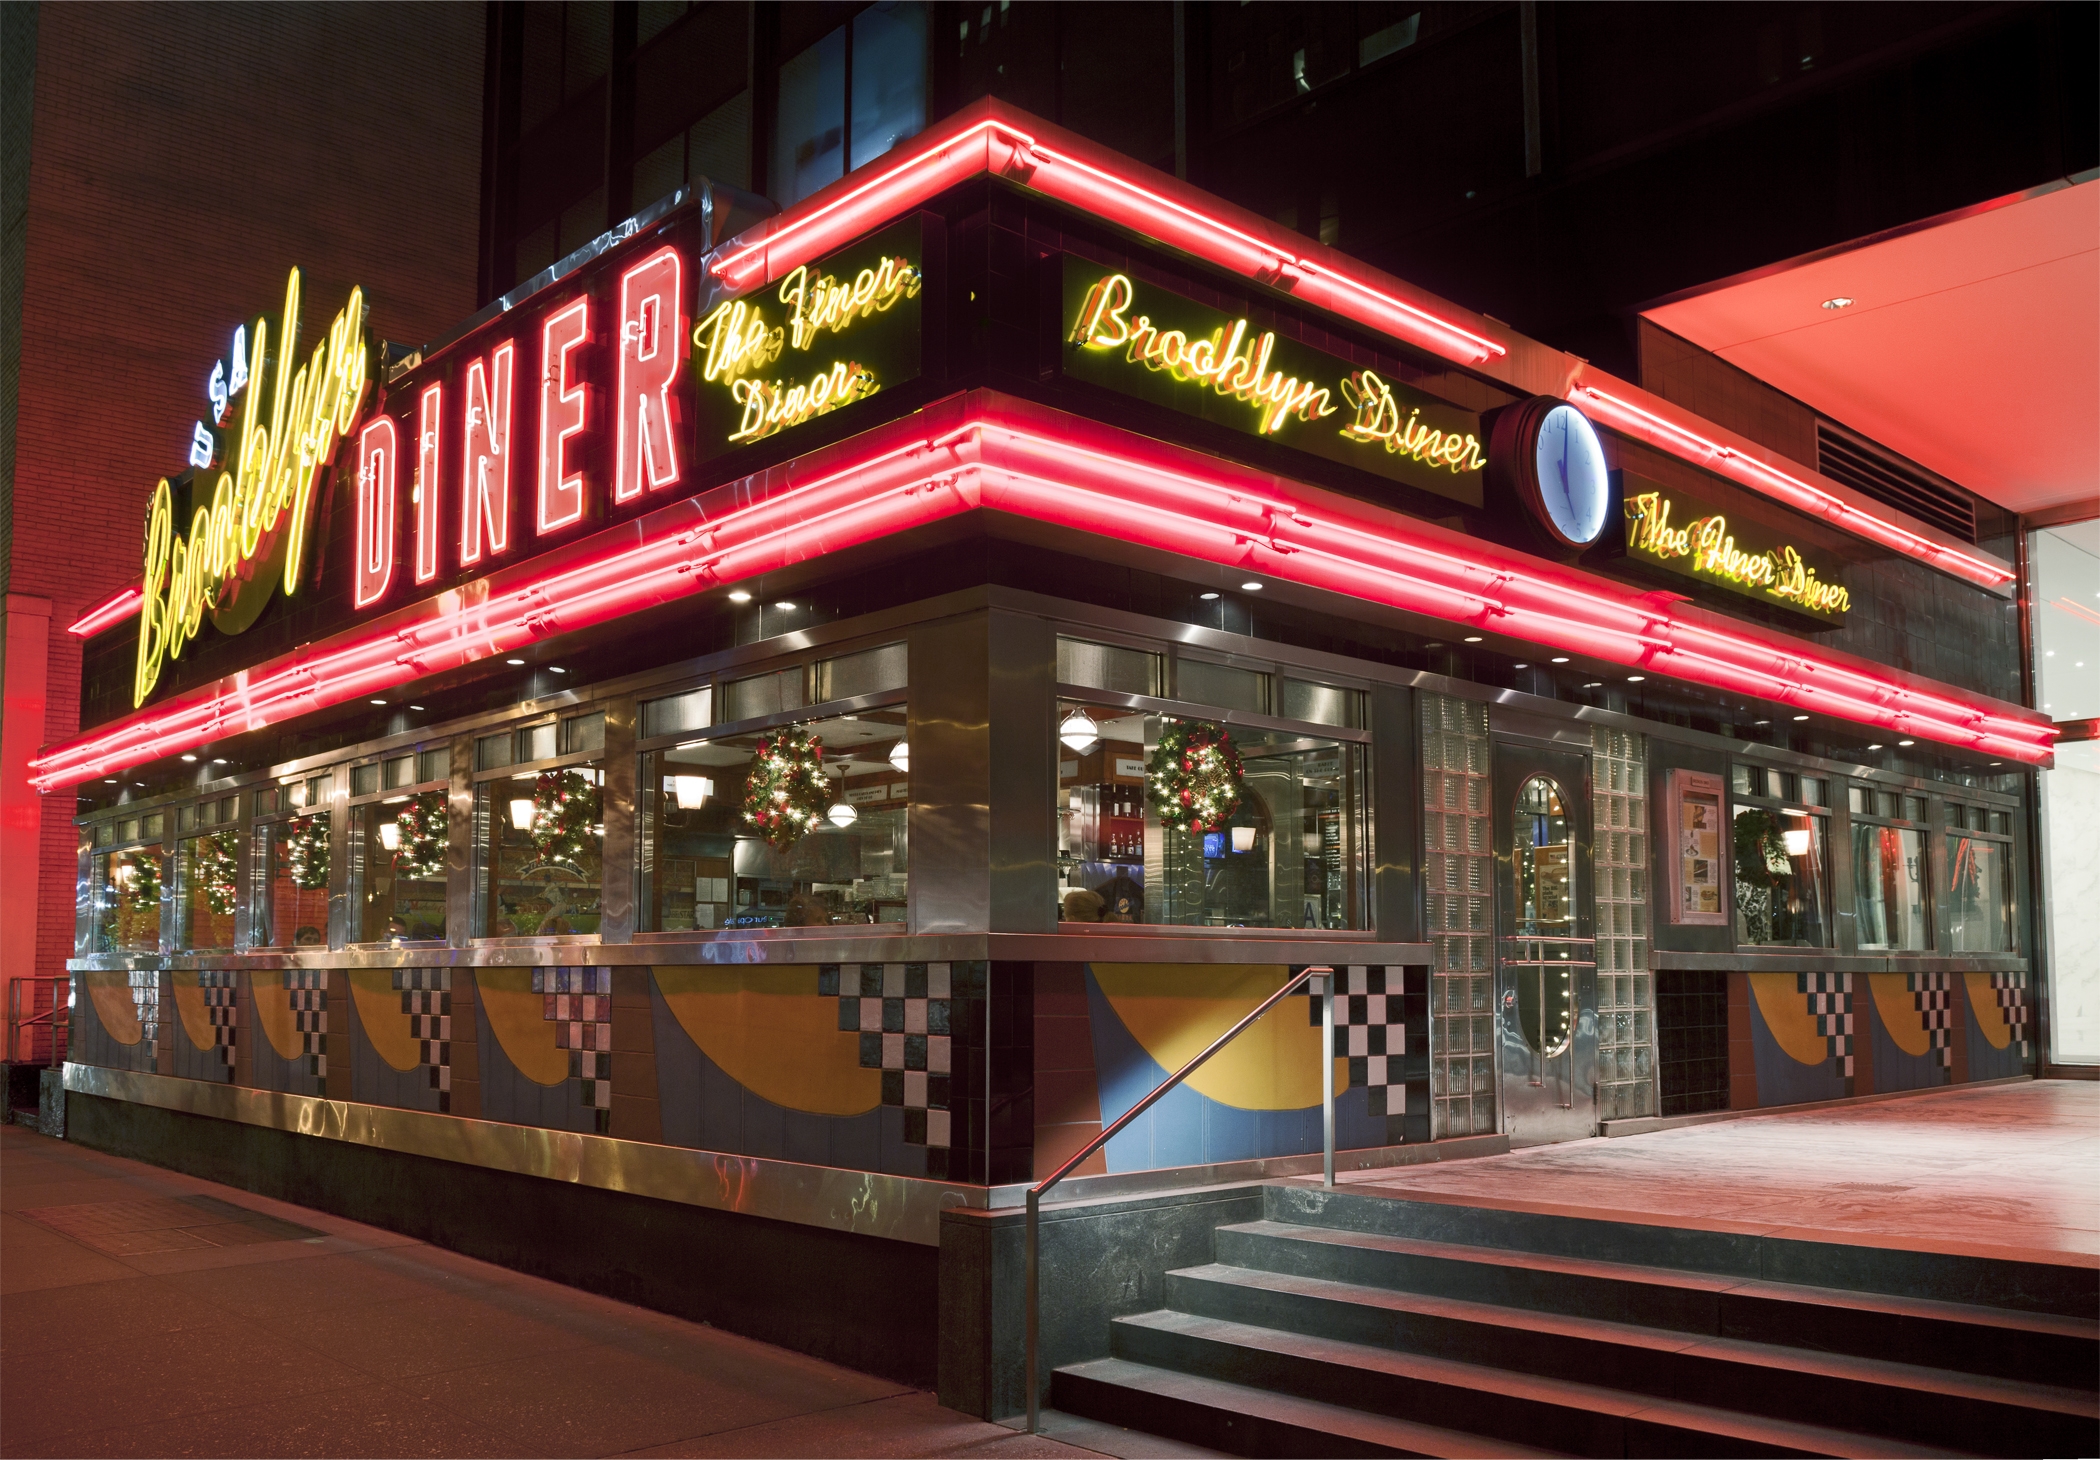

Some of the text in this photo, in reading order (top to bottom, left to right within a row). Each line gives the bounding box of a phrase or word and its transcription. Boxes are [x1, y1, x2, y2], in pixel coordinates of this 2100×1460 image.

[693, 257, 914, 381] The Finer
[1086, 274, 1488, 470] Brooklyn Diner
[354, 245, 686, 610] DINER
[728, 361, 862, 442] Diner
[133, 264, 368, 710] Brooklyn
[1638, 491, 1851, 613] The Finer Diner
